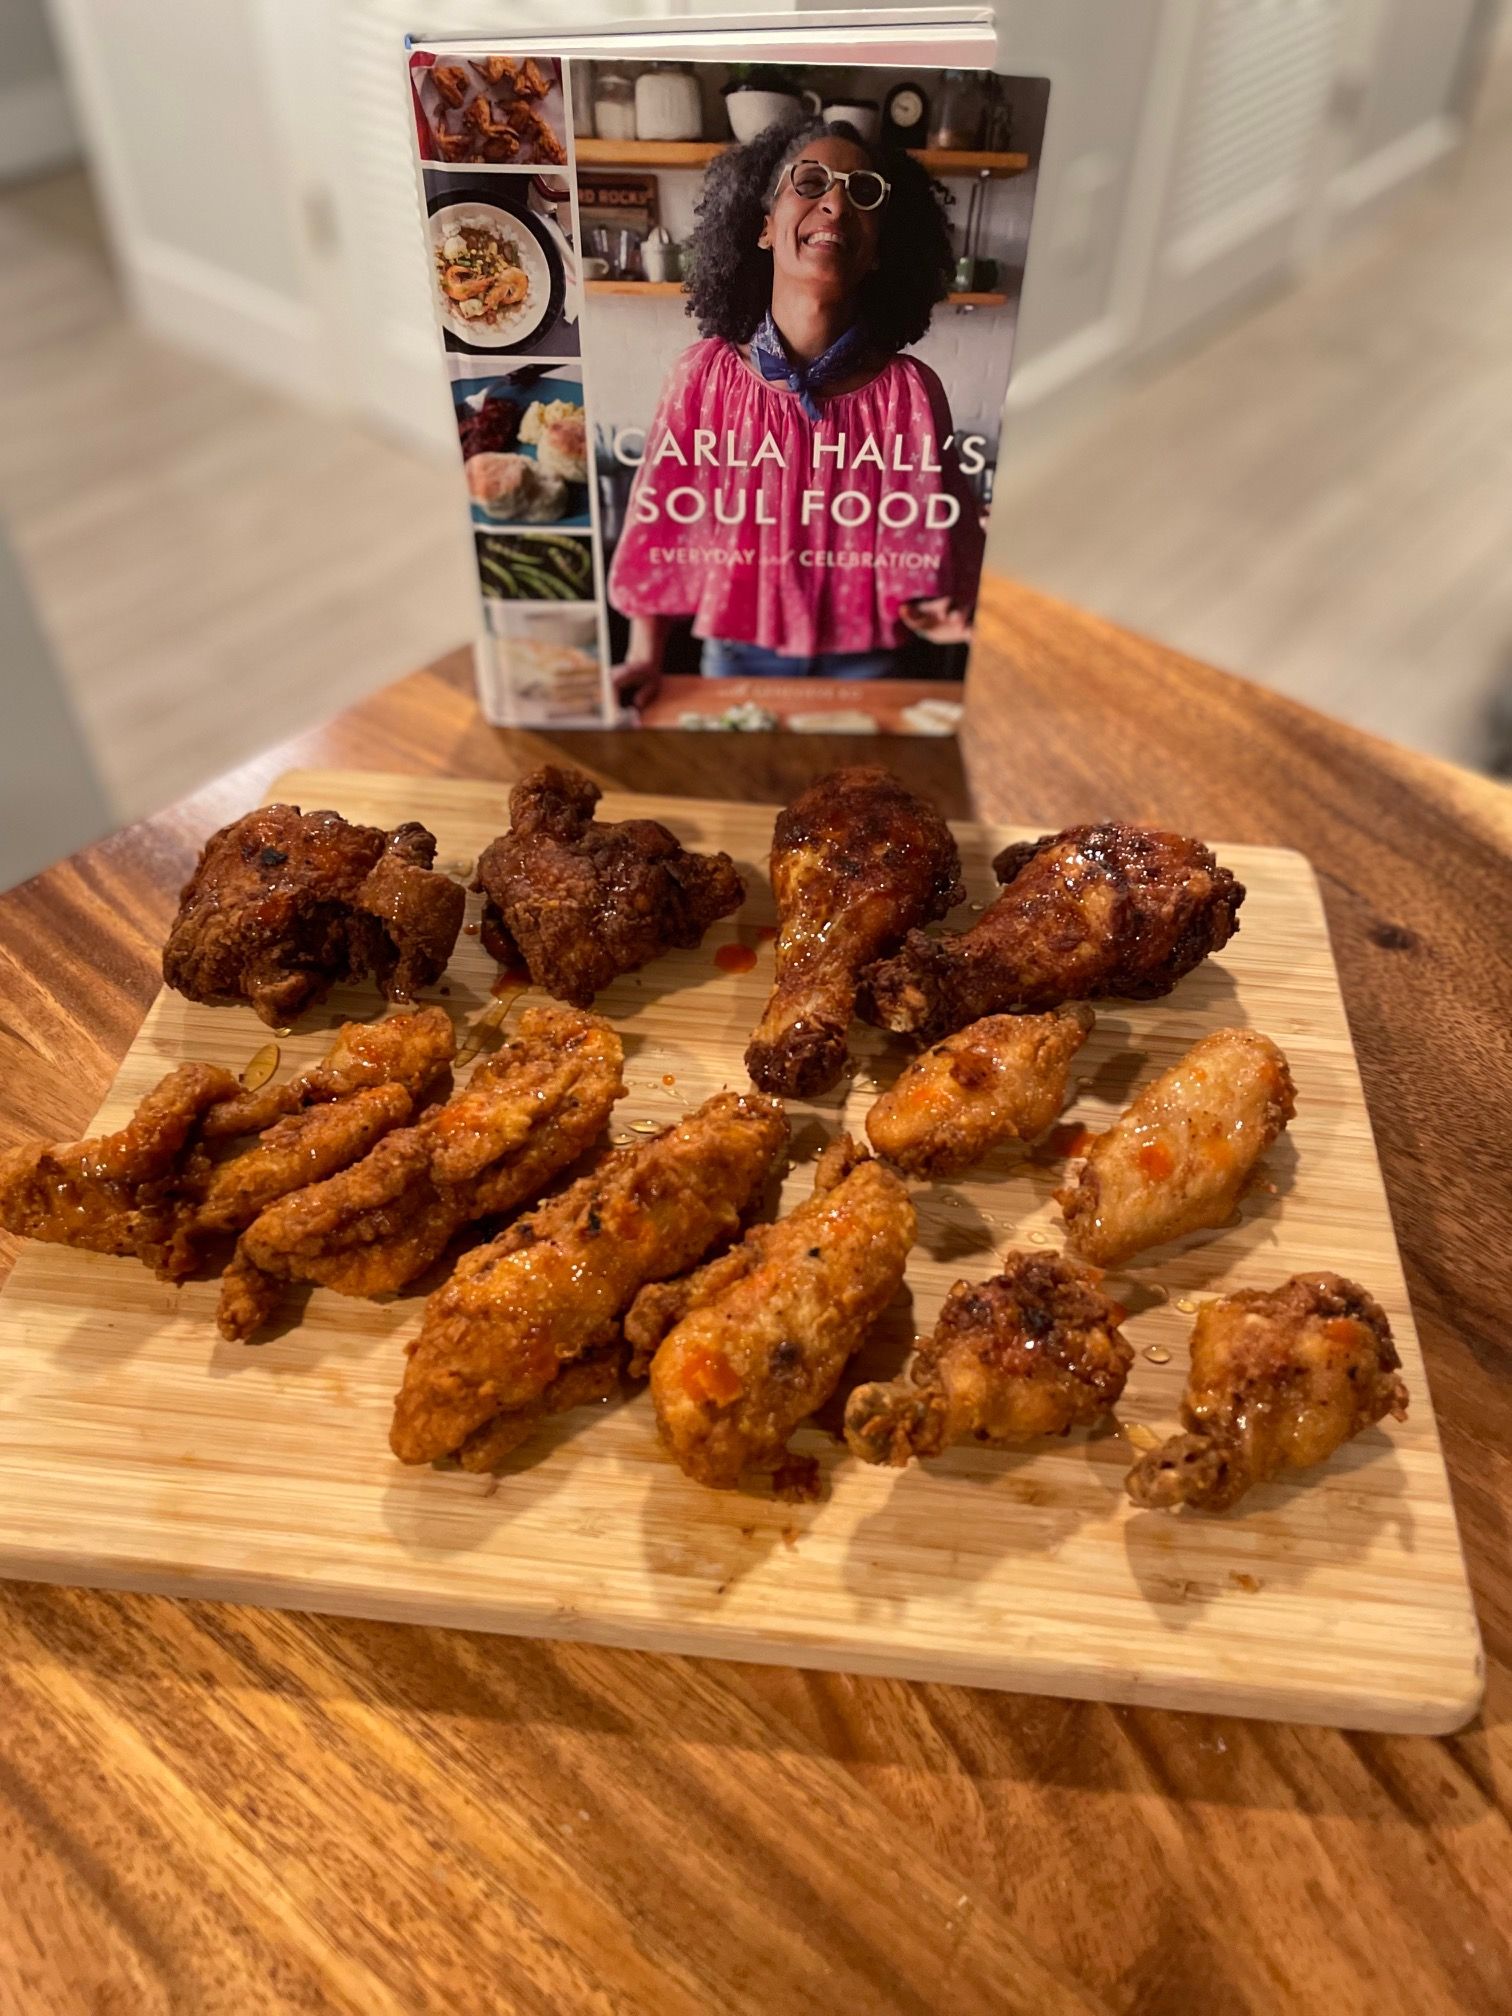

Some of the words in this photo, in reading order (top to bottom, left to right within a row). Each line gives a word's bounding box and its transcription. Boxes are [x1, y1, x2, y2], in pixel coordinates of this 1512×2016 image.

[613, 428, 787, 468] CARLA
[812, 431, 987, 475] HALL'S
[634, 486, 777, 526] SOUL
[801, 490, 961, 529] FOOD
[648, 546, 756, 567] EVERYDAY
[799, 549, 940, 570] CELEBRATION
